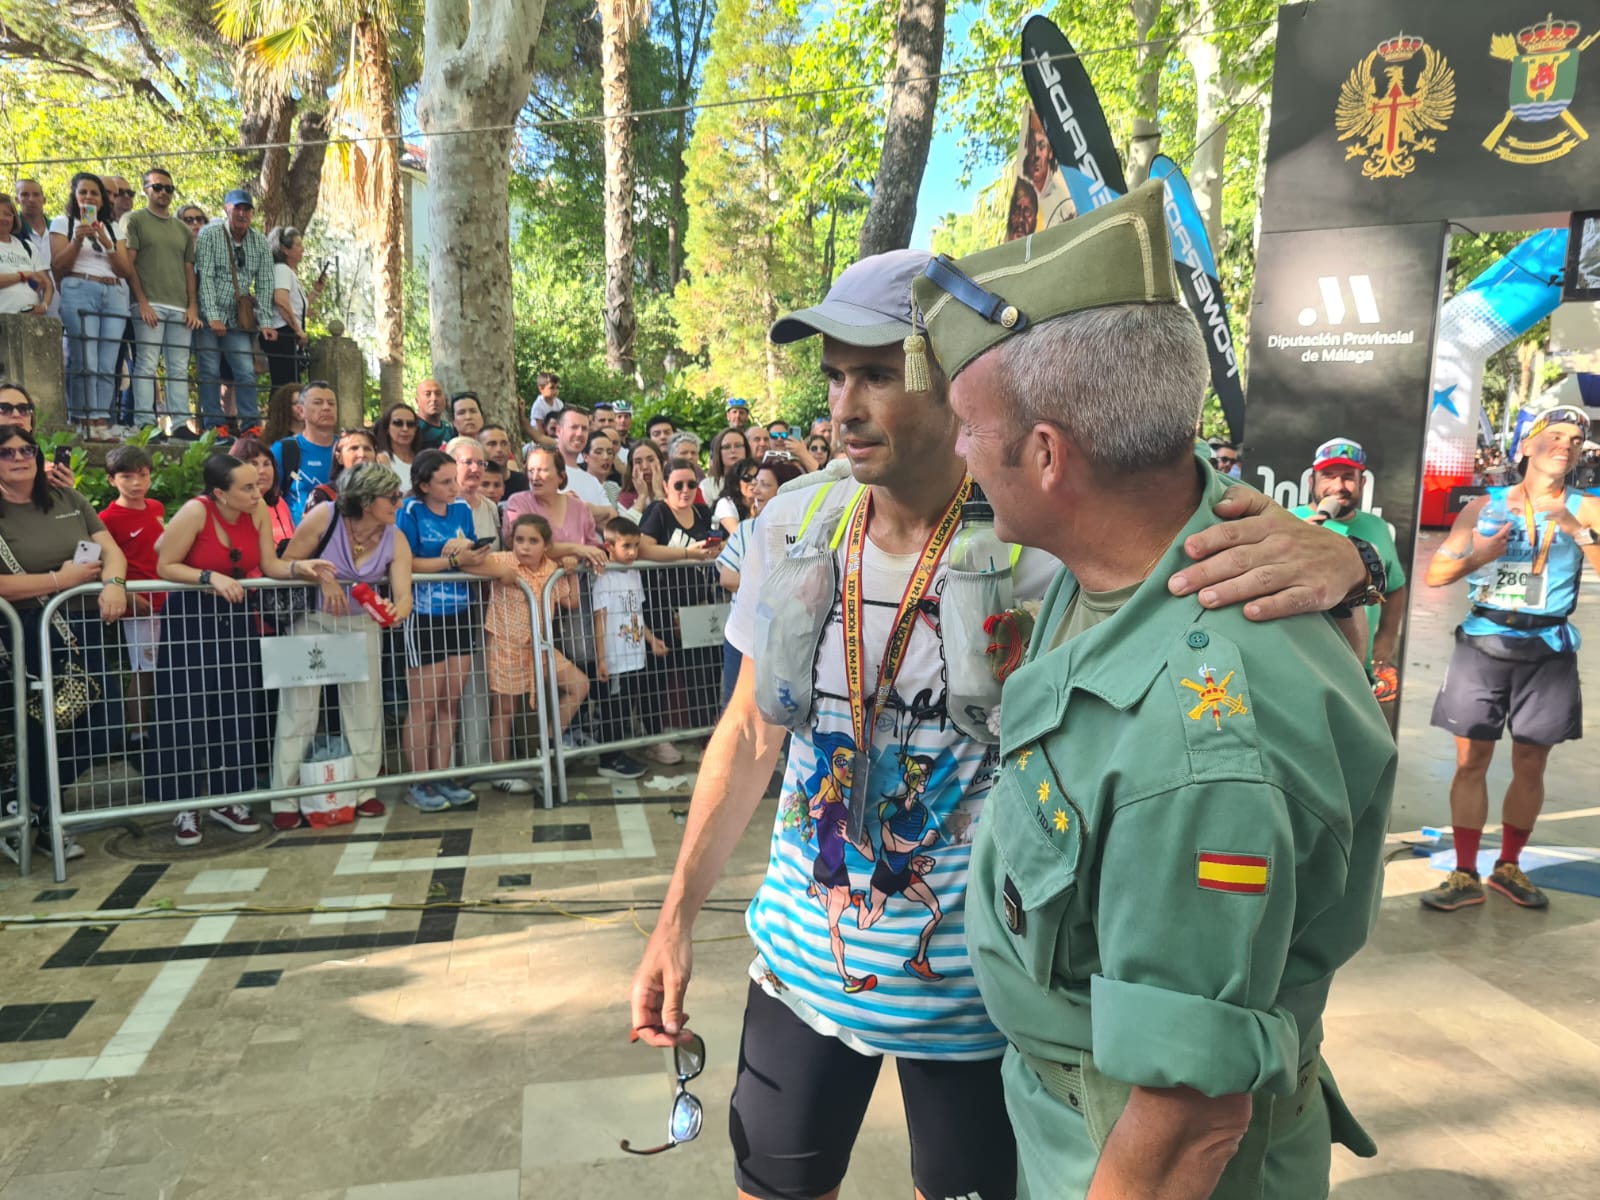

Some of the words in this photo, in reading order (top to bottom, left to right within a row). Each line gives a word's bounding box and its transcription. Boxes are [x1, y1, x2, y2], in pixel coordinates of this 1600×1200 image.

[1268, 332, 1340, 350] Diputación
[1342, 330, 1414, 346] Provincial
[1301, 350, 1319, 362] de
[1322, 348, 1374, 364] Málaga
[926, 545, 938, 560] LA
[949, 499, 963, 517] NOS
[847, 579, 857, 597] XXIV
[848, 635, 858, 647] 101
[848, 647, 858, 664] KM
[849, 665, 858, 676] 24
